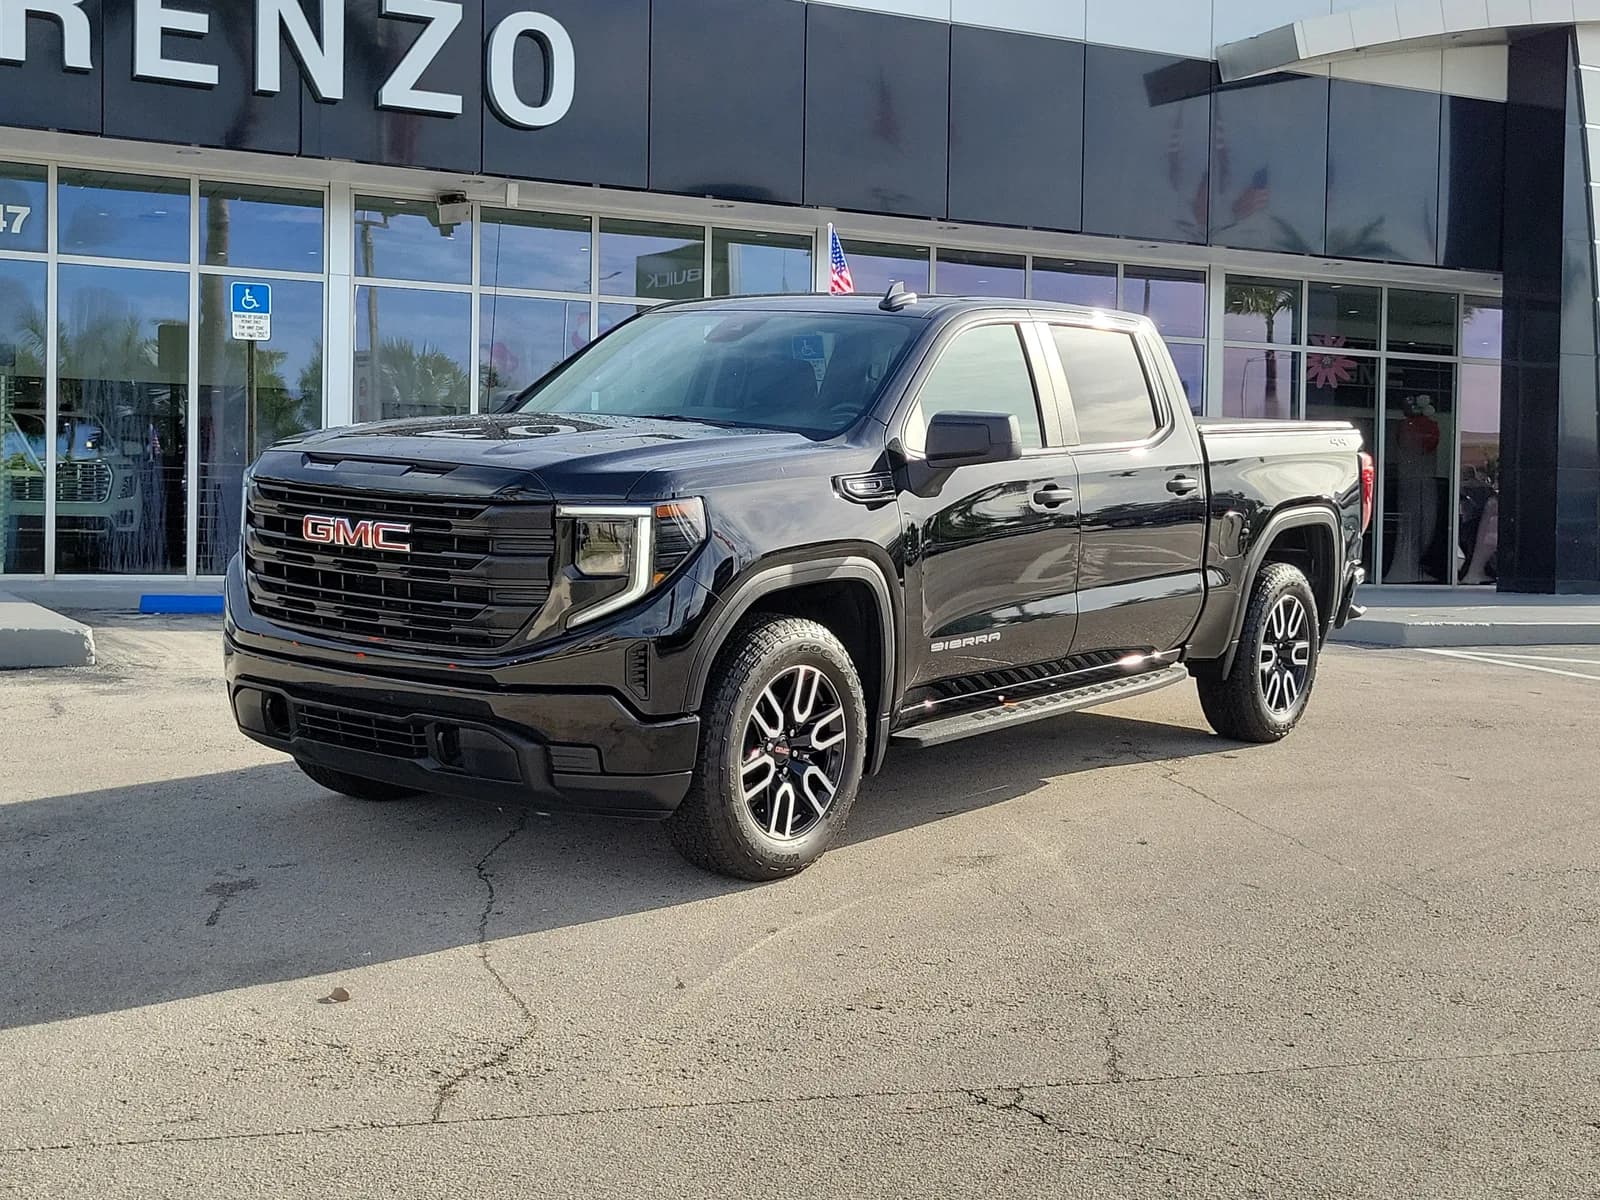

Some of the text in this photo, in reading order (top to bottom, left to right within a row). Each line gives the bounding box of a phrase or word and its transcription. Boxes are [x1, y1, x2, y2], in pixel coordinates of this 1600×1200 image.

[0, 204, 30, 233] 7
[303, 514, 411, 552] GMC
[930, 632, 1001, 652] SIERRA
